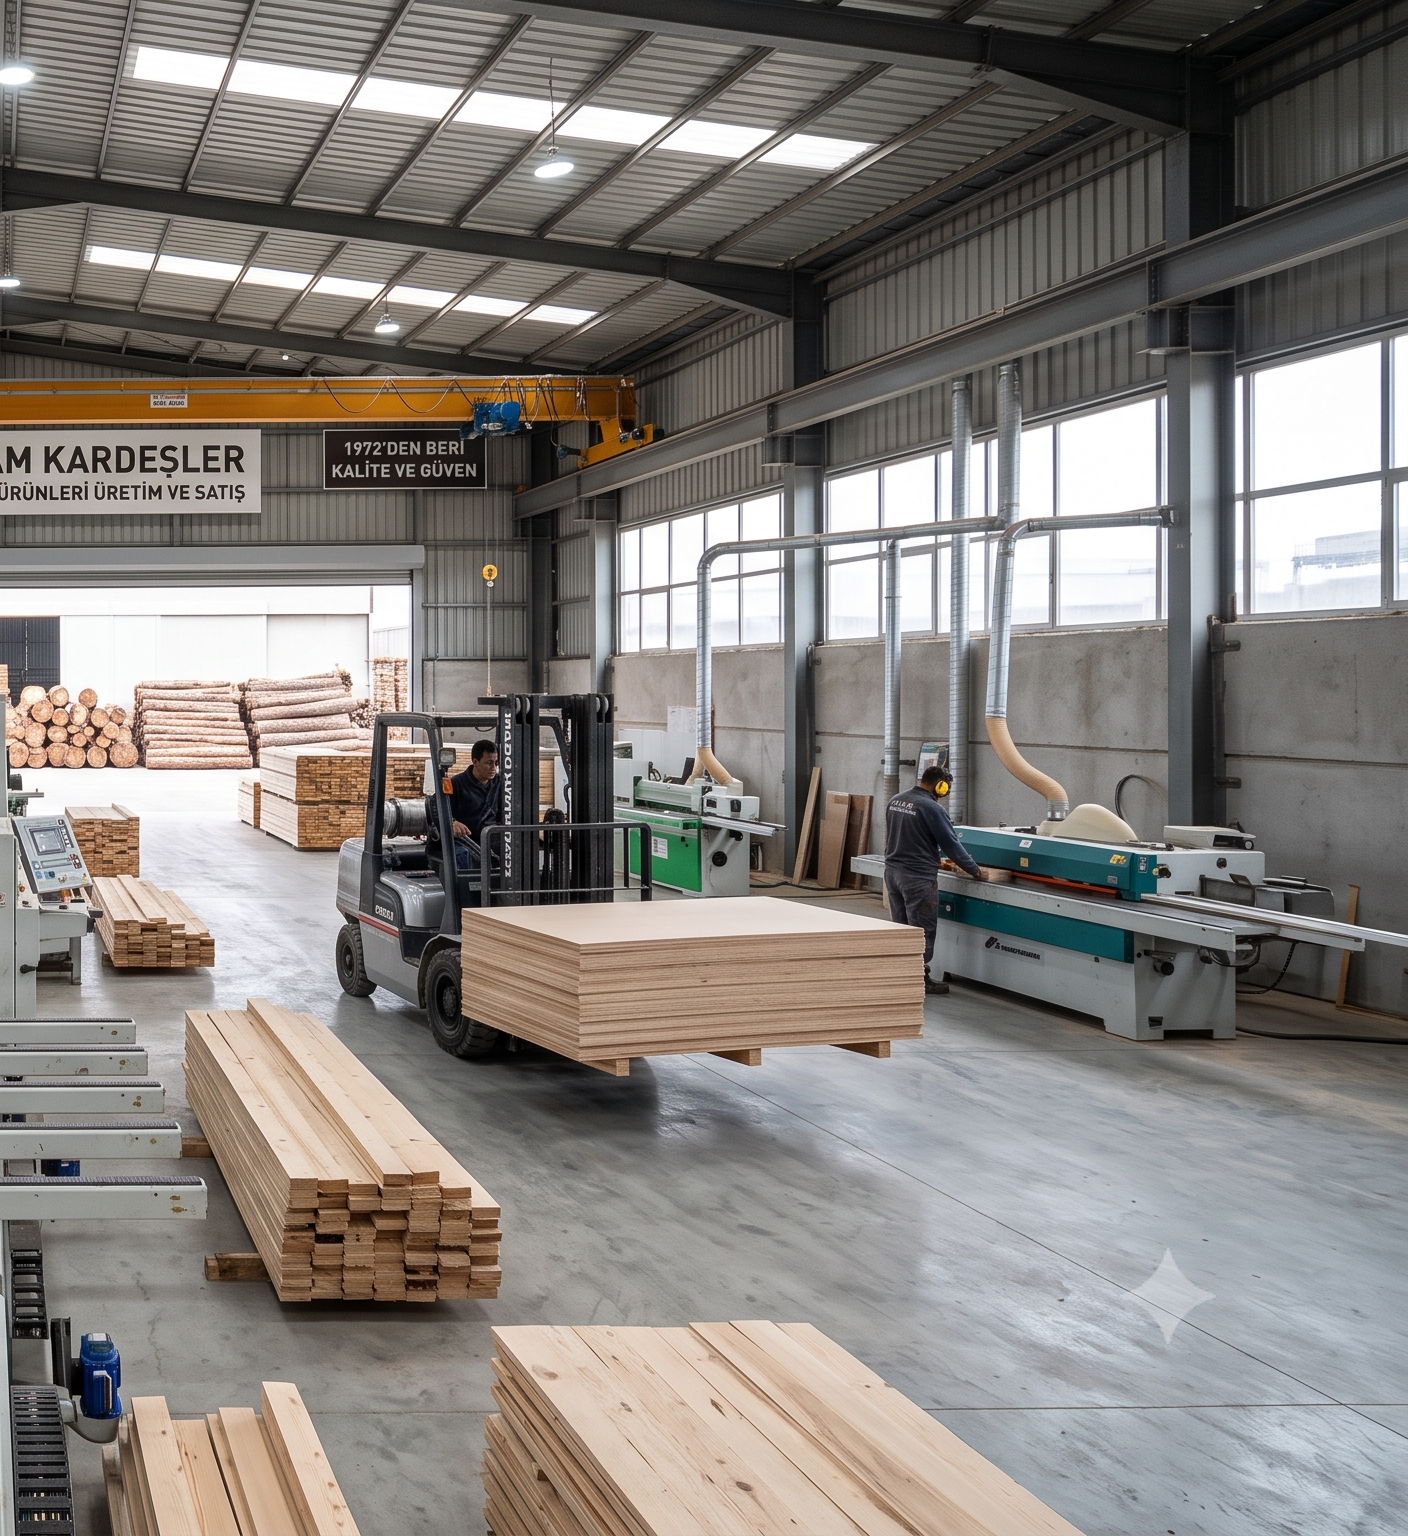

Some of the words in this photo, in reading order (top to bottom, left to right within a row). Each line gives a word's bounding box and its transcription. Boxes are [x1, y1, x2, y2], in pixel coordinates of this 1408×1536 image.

[344, 441, 421, 456] 1972'DEN
[44, 445, 245, 479] KARDEŞLER
[332, 460, 391, 478] KALİTE
[395, 463, 416, 478] VE
[420, 460, 477, 478] GÜVEN
[94, 480, 163, 501] ÜRETİM
[168, 484, 190, 501] VE
[195, 484, 246, 503] SATIŞ
